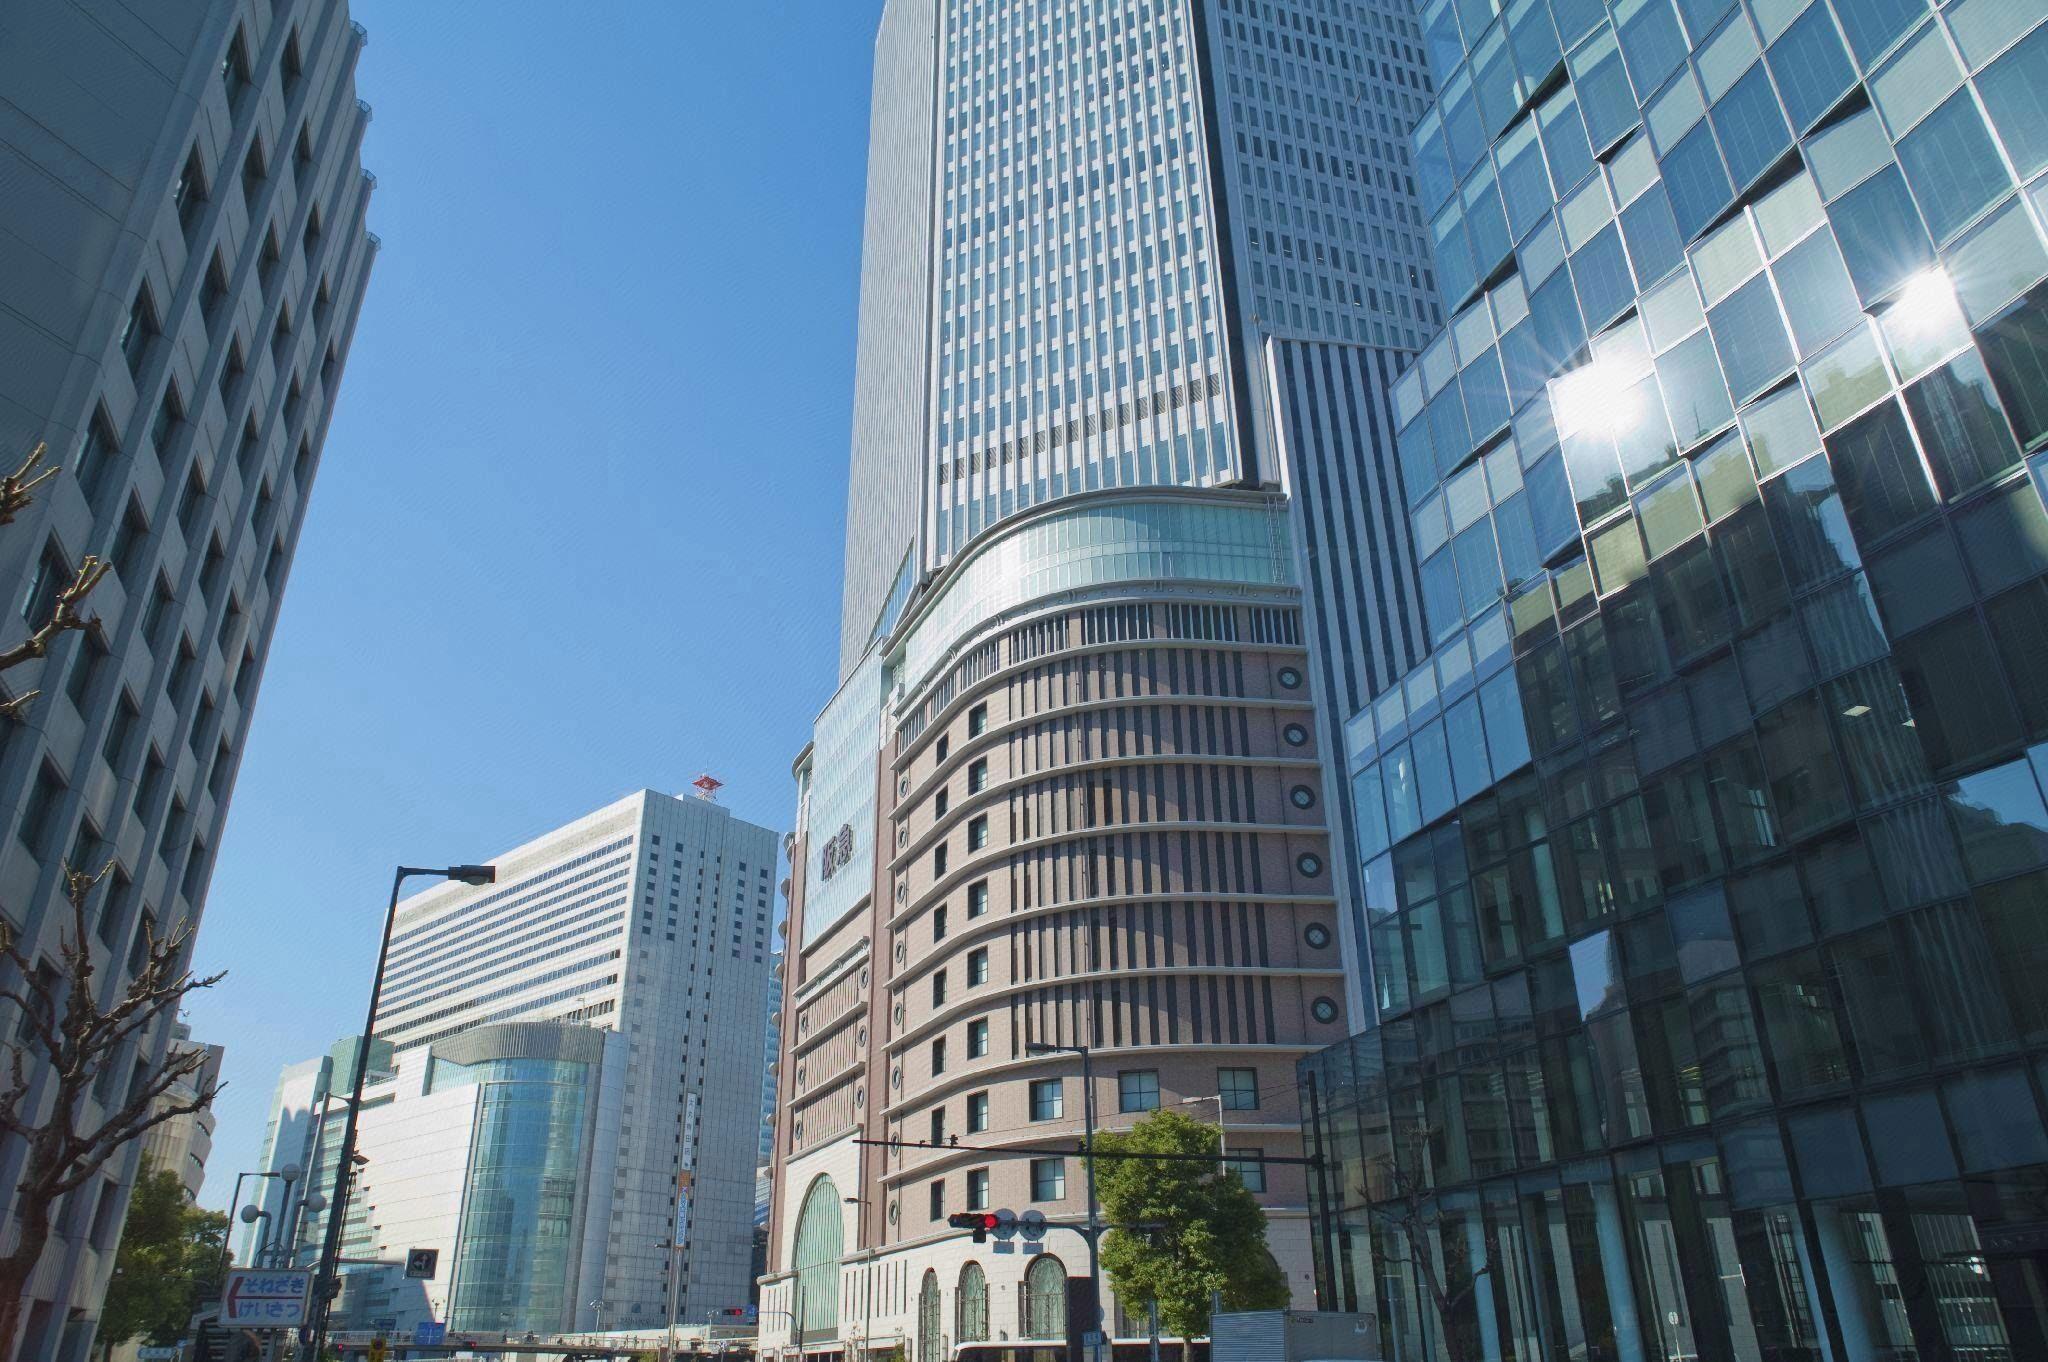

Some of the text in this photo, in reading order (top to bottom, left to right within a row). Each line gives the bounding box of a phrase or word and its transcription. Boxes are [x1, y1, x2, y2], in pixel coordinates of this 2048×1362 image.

[821, 824, 852, 882] 阪急
[244, 1276, 304, 1293] そねざき
[239, 1301, 299, 1317] けいさつ
